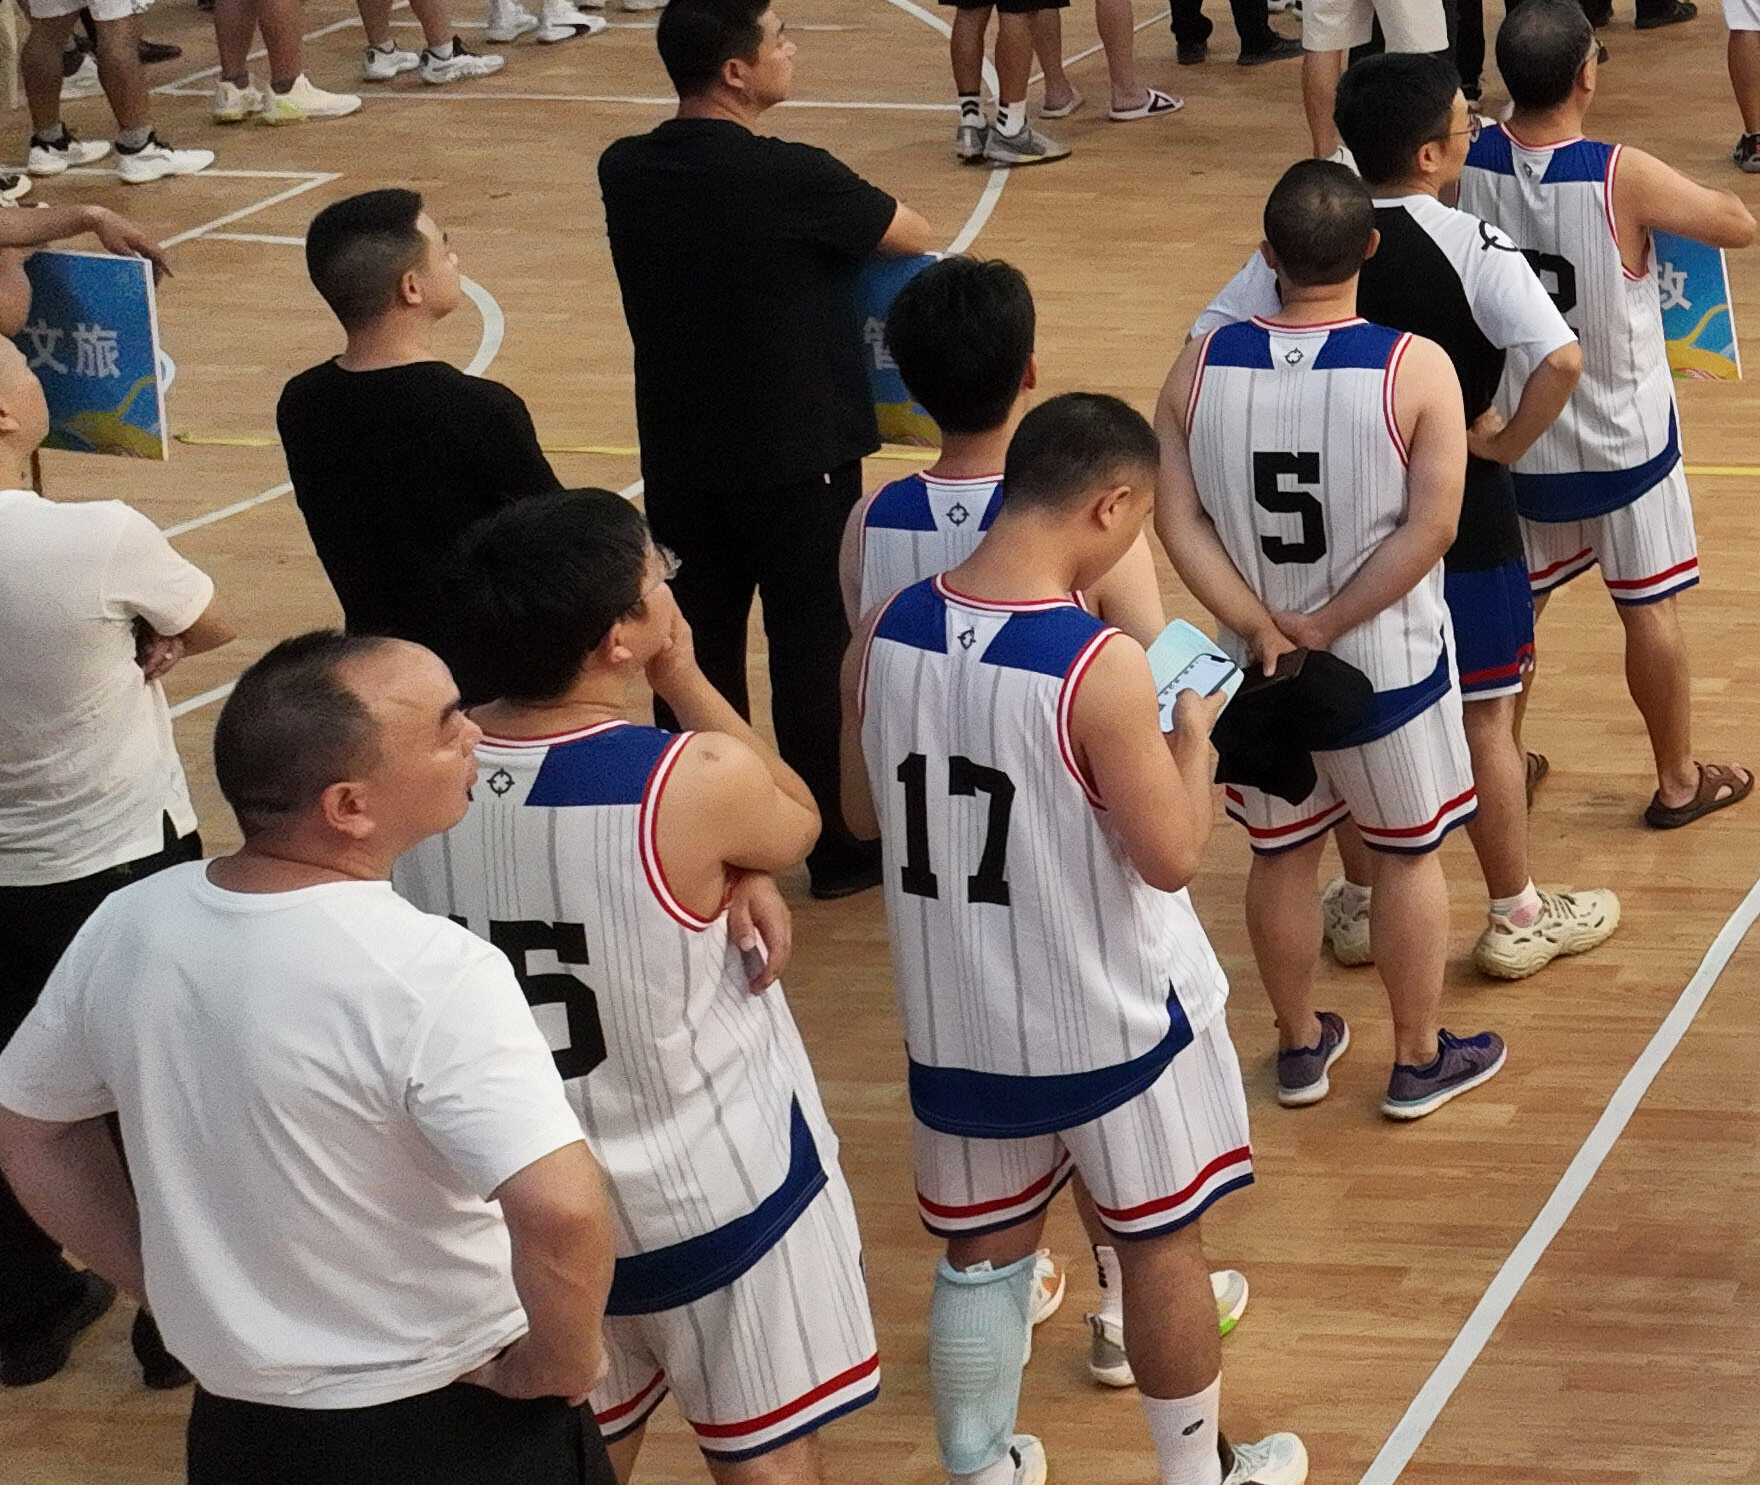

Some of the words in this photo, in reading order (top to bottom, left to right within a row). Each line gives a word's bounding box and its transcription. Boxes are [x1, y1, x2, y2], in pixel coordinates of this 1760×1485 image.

[22, 317, 121, 380] 文旅
[1251, 450, 1327, 566] 5
[896, 752, 1017, 907] 17
